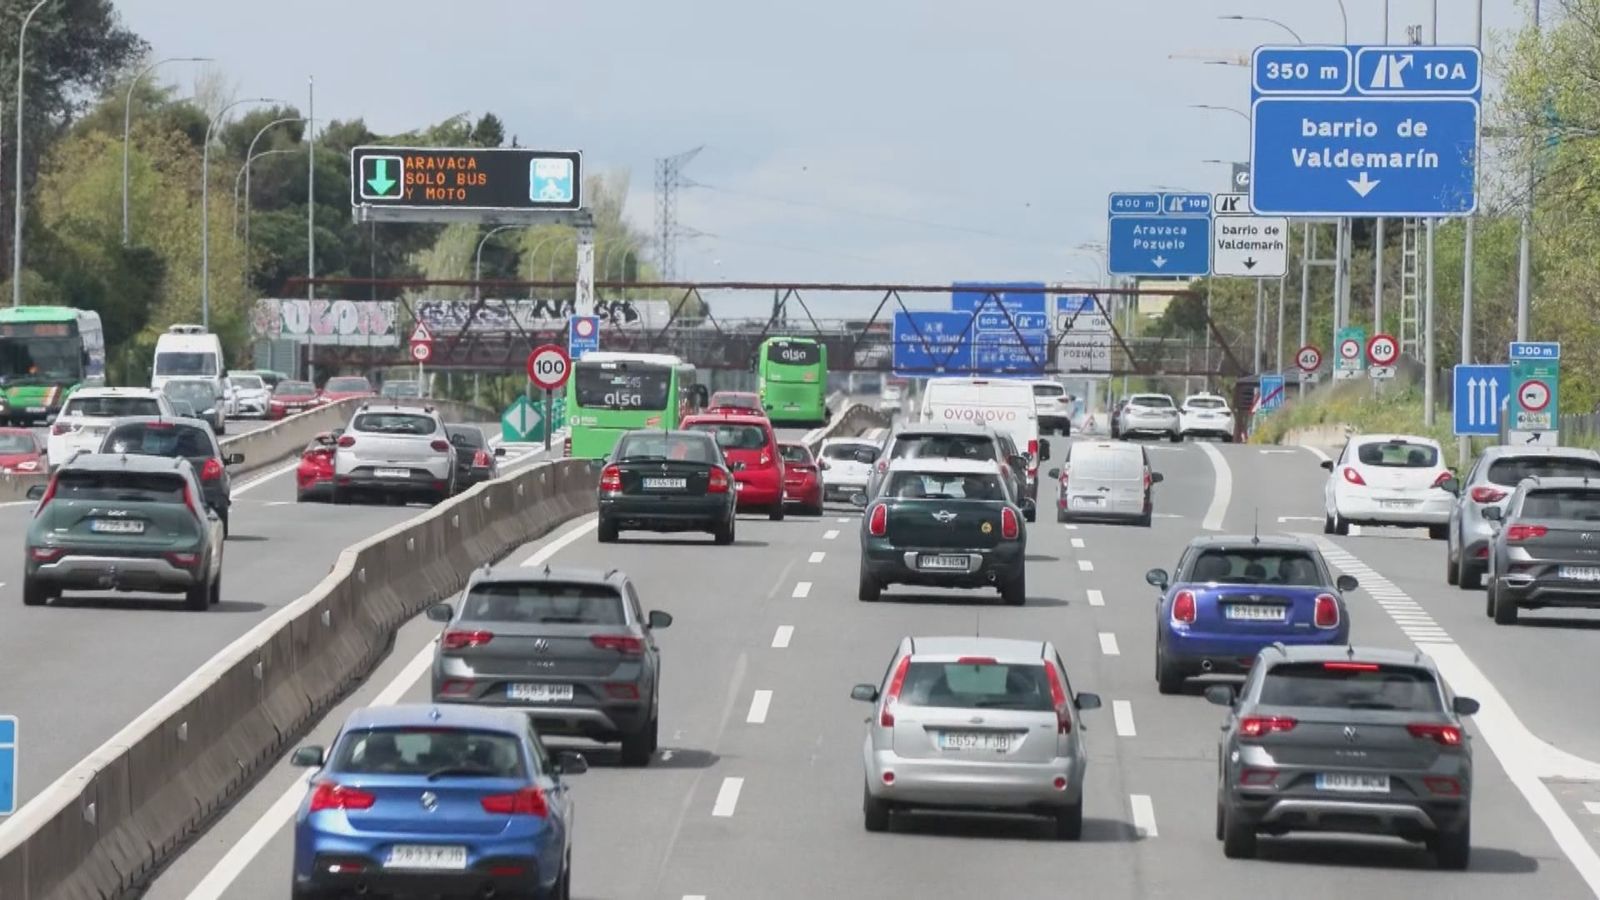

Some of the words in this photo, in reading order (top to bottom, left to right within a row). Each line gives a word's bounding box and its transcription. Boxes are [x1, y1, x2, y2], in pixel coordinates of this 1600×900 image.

[1266, 62, 1309, 79] 350
[1320, 65, 1338, 79] m
[1424, 63, 1467, 79] 10A
[1302, 118, 1378, 137] barrio
[1397, 118, 1428, 137] de
[406, 156, 477, 169] ARAVACA
[1291, 148, 1439, 168] Valdemarín
[406, 172, 446, 185] SOLO
[457, 173, 487, 185] BUS
[406, 188, 413, 200] Y
[426, 188, 466, 200] MOTO
[1116, 199, 1140, 208] 400
[1145, 200, 1154, 208] m
[1189, 199, 1208, 208] 10B
[1133, 225, 1187, 235] Aravaca
[1222, 225, 1258, 235] barrio
[1264, 225, 1279, 235] de
[1133, 238, 1185, 250] Pozuelo
[1218, 239, 1284, 250] Valdemarín
[782, 348, 806, 360] alsa
[1374, 345, 1392, 355] 80
[1518, 346, 1541, 355] 300
[1302, 354, 1317, 363] 40
[536, 360, 564, 375] 100
[604, 390, 641, 406] alsa
[944, 408, 1016, 421] OVONOVO
